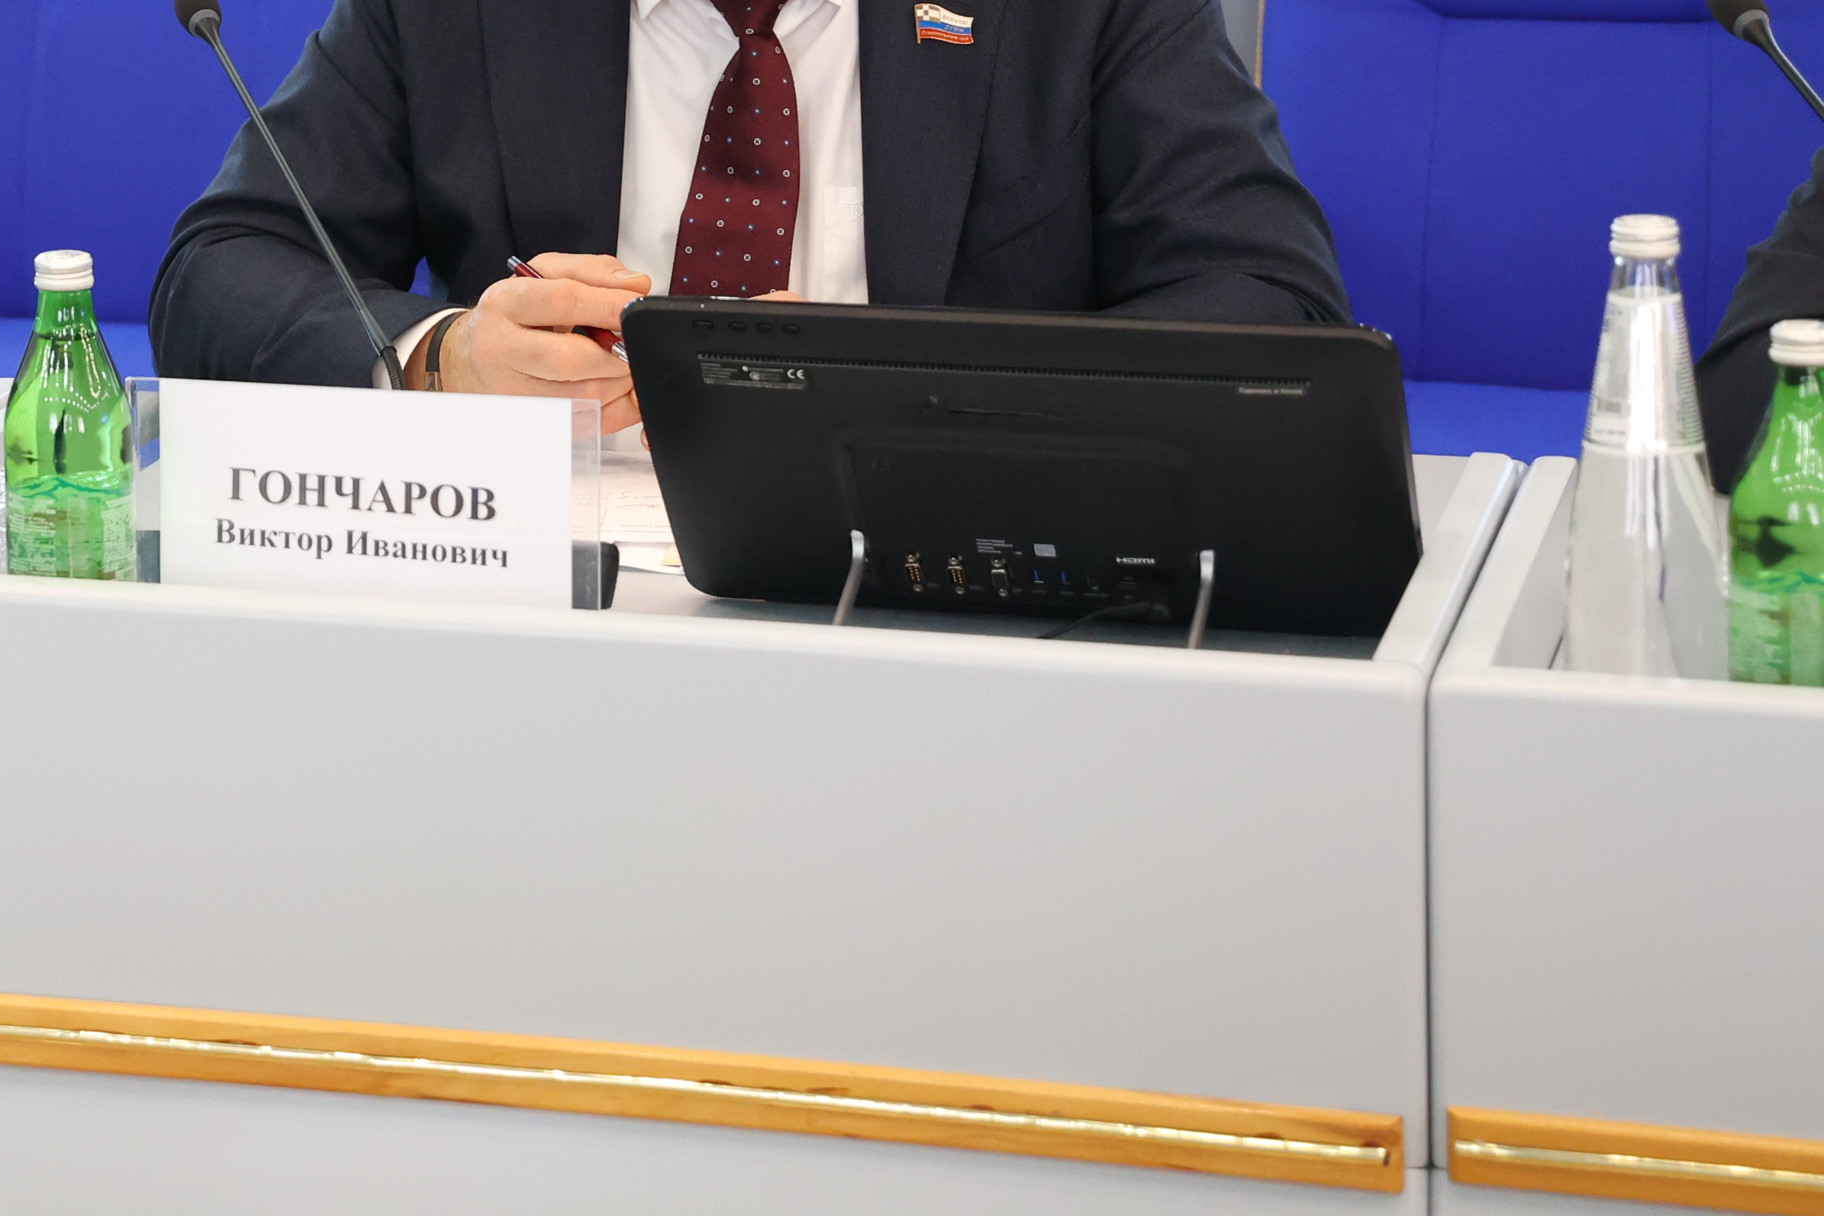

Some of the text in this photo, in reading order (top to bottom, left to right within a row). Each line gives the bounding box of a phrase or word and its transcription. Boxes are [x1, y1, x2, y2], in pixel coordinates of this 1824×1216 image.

[228, 467, 496, 520] ГОНЧАРОВ
[215, 518, 508, 568] Виктор Иванович
